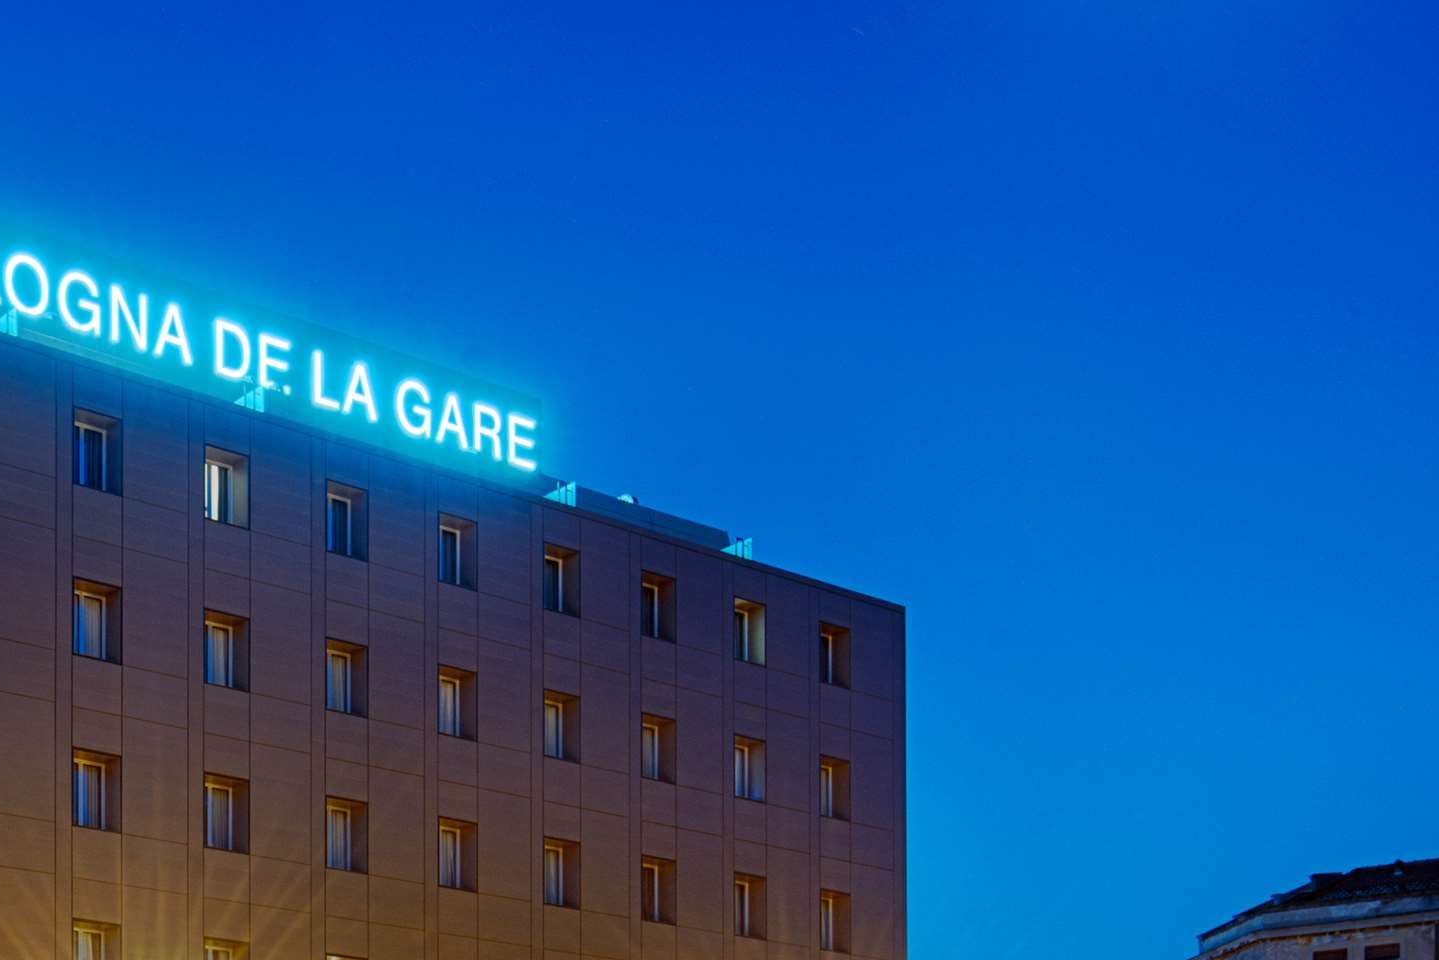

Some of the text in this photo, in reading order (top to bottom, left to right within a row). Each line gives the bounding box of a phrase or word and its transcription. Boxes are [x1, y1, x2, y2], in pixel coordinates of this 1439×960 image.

[213, 316, 292, 393] DE
[311, 348, 378, 423] LA
[393, 377, 537, 472] GARE
